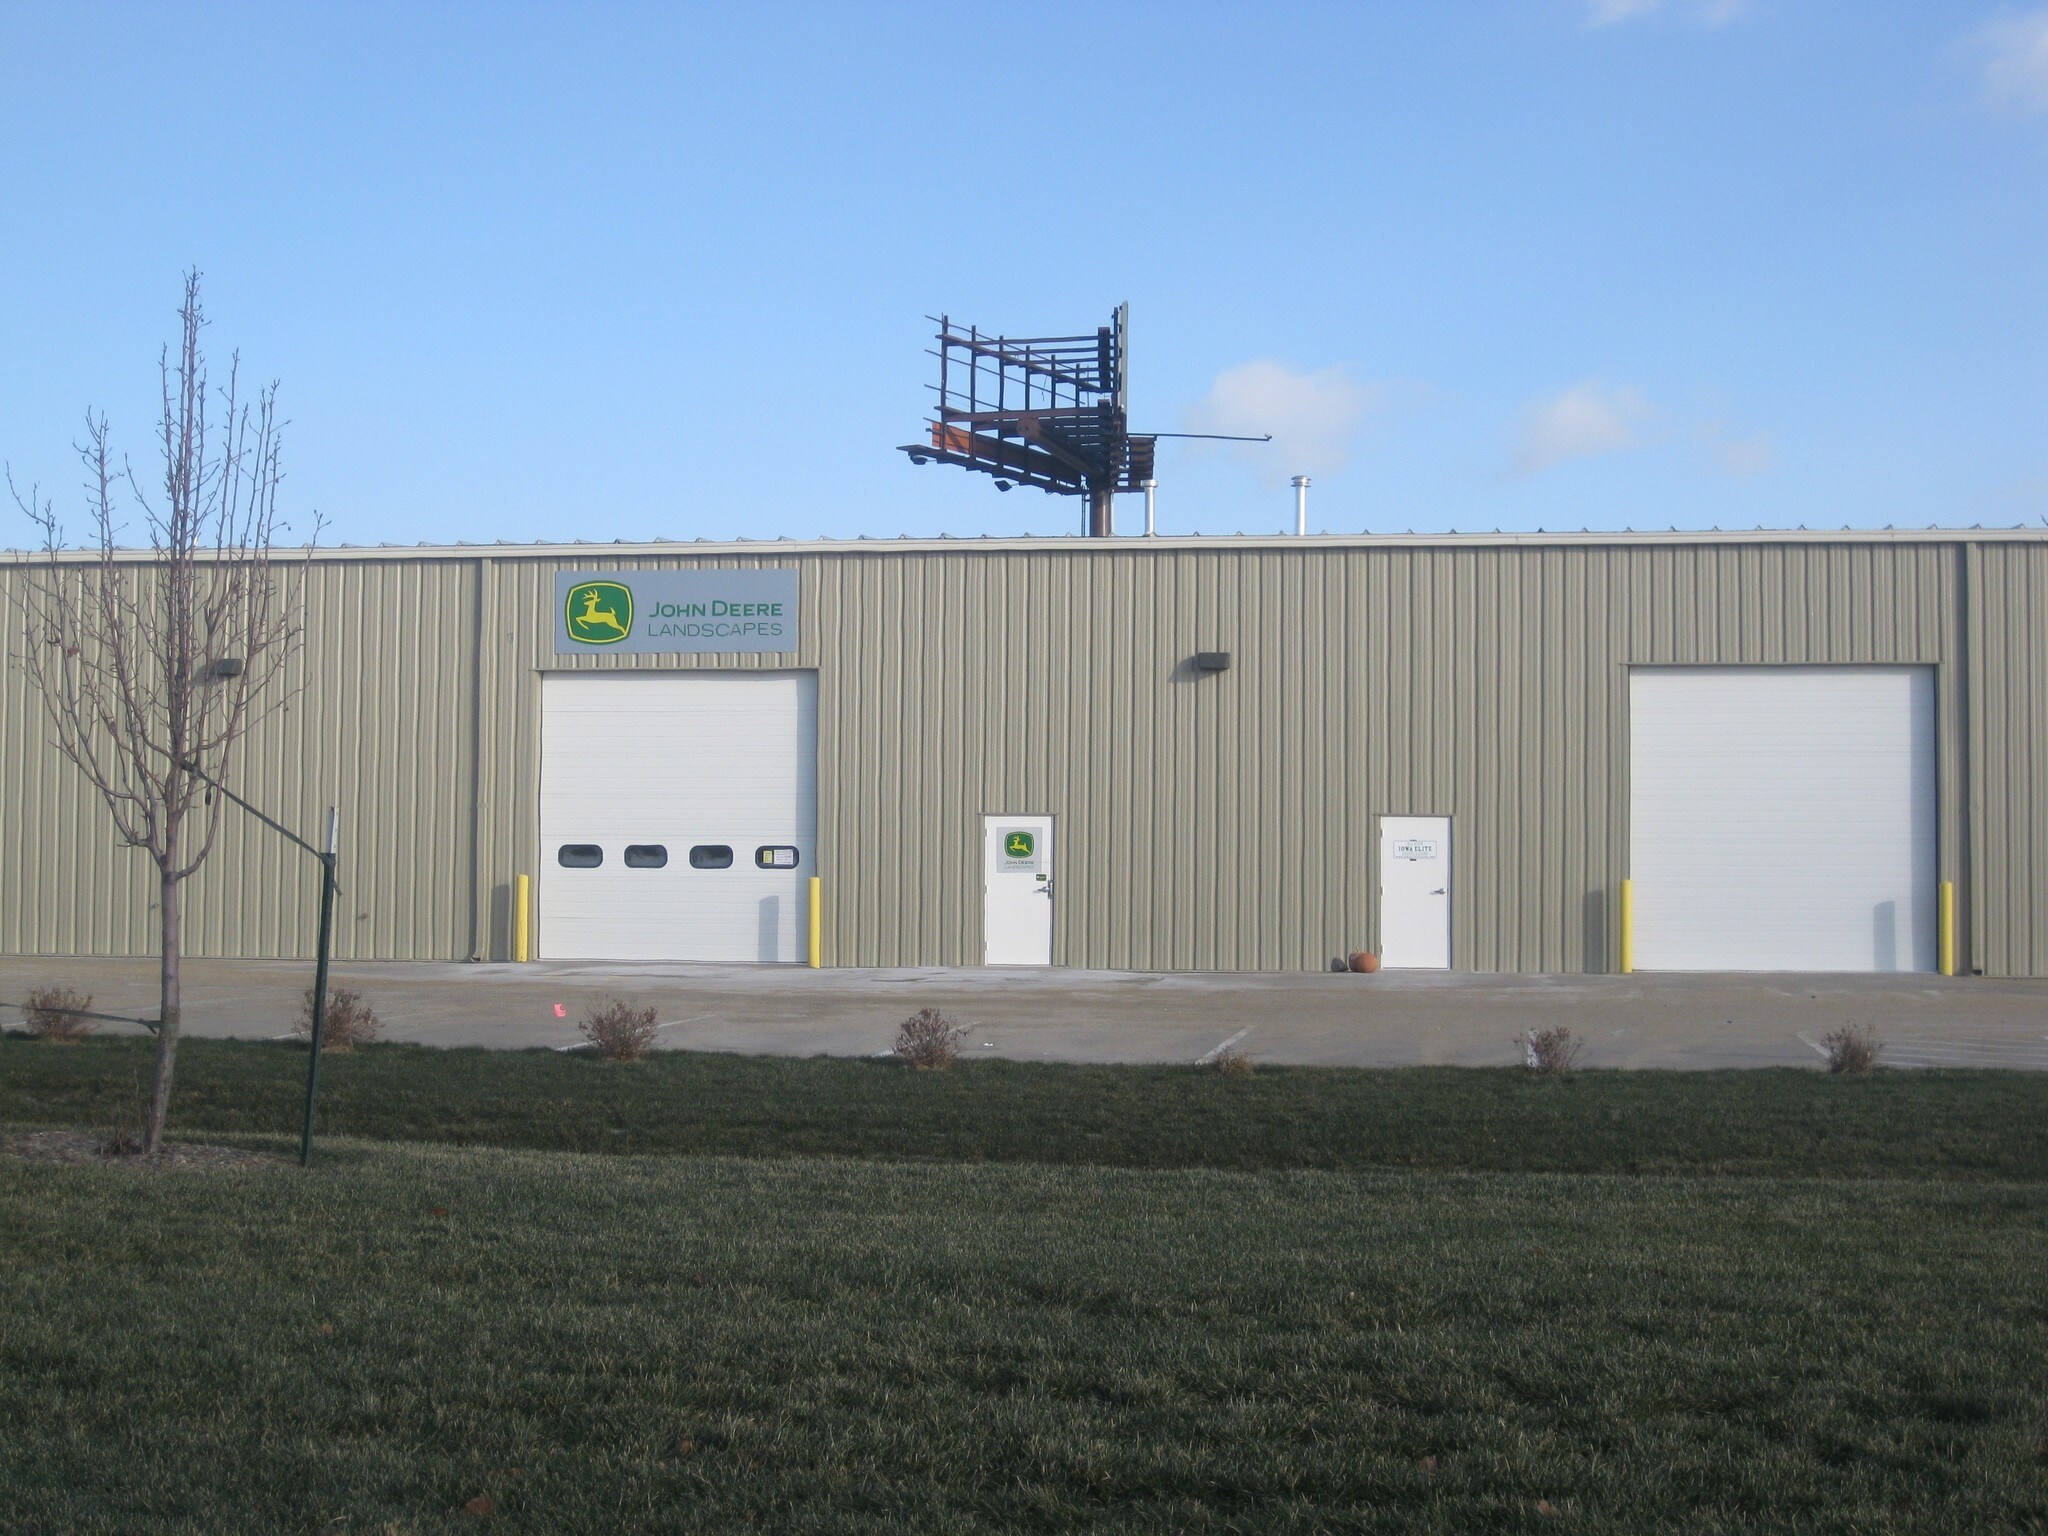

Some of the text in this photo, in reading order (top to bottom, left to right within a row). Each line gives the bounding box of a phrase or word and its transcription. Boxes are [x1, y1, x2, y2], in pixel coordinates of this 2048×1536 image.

[649, 600, 783, 618] JOHN DEERE
[648, 622, 783, 637] LANDSCAPES
